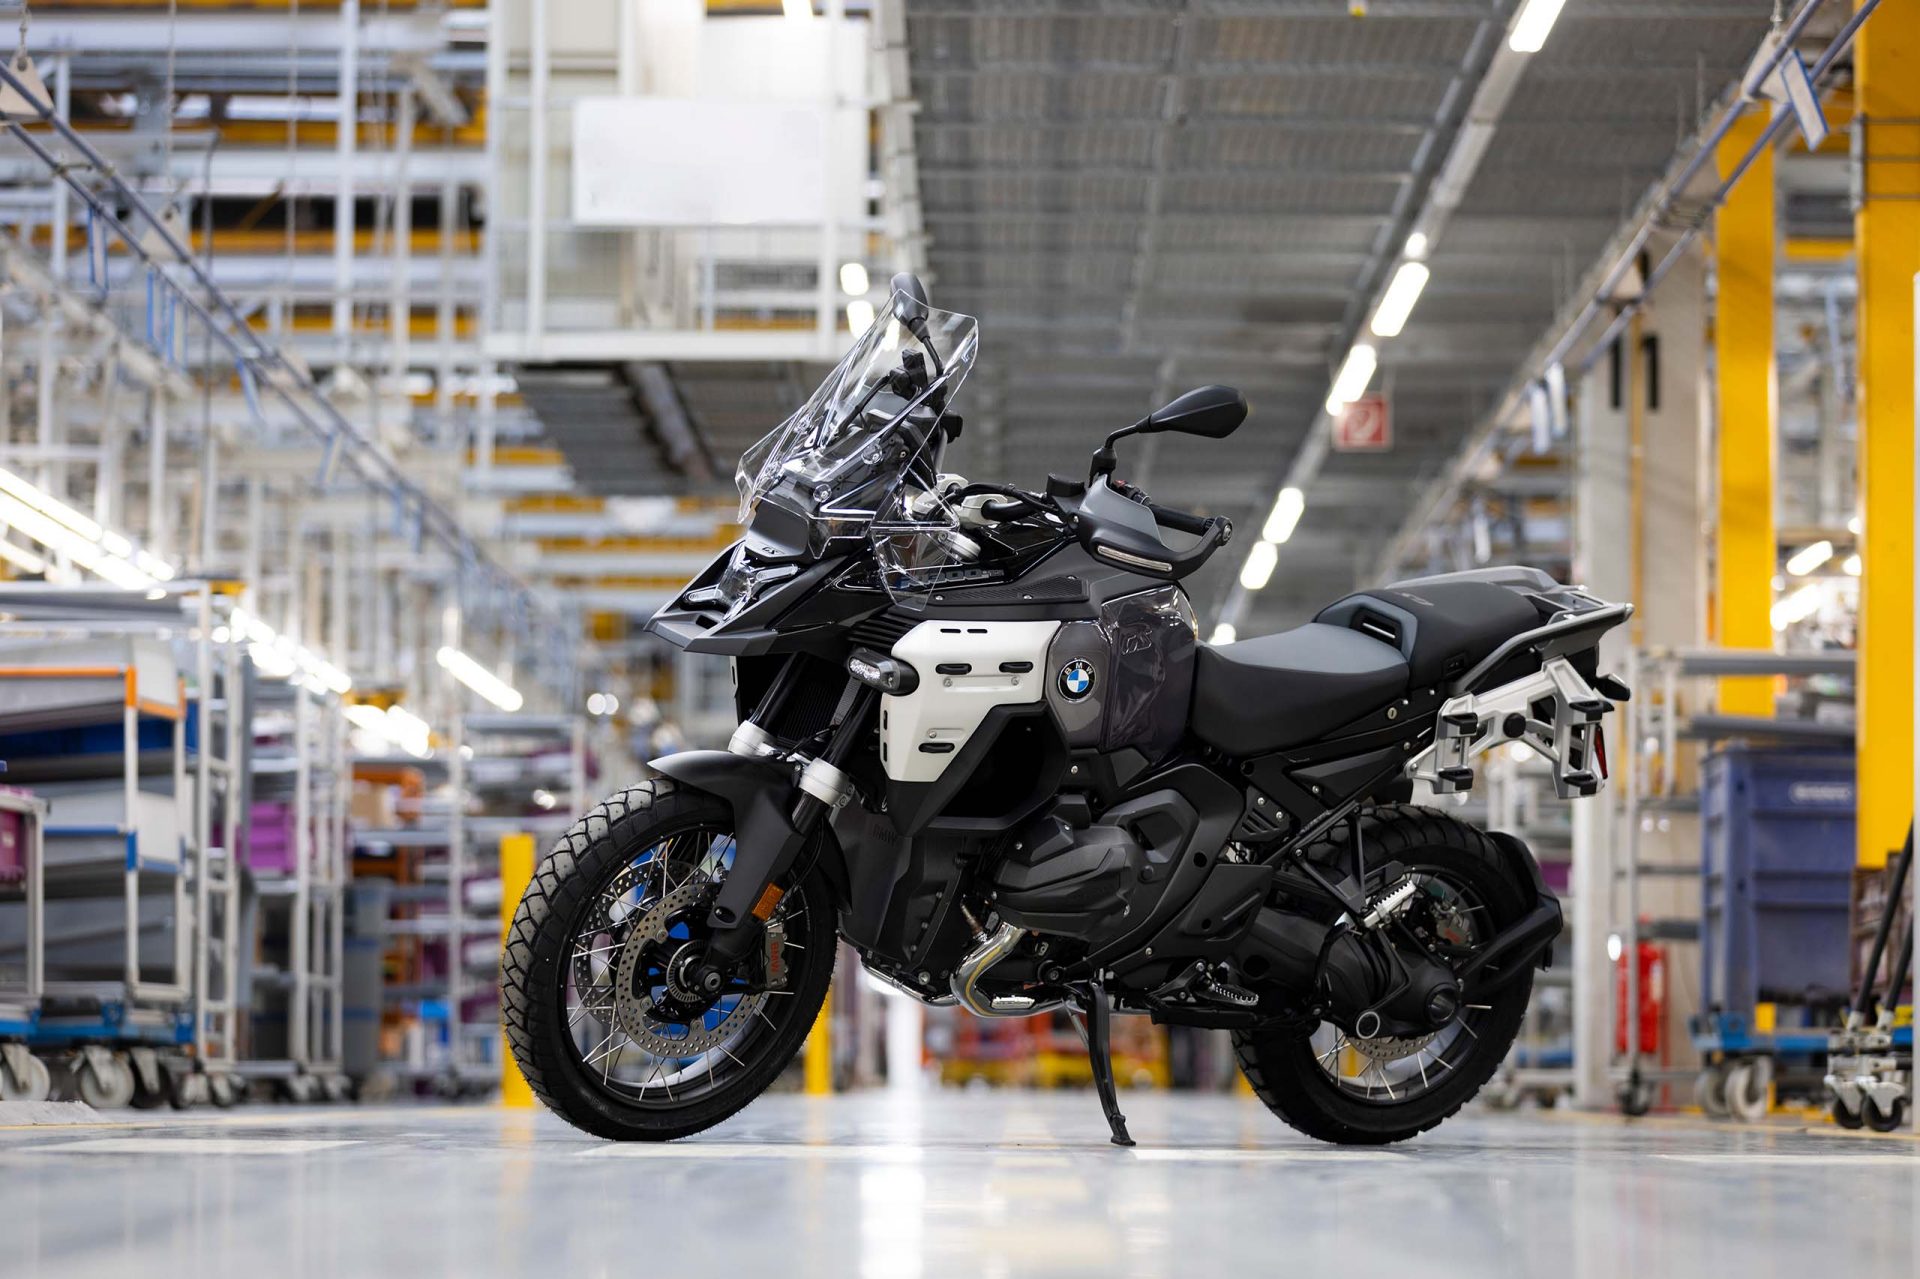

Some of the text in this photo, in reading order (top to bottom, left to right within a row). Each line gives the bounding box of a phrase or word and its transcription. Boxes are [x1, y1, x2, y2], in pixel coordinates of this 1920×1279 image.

[1121, 630, 1153, 655] GS
[1064, 662, 1094, 675] BMW
[770, 942, 779, 973] BMW
